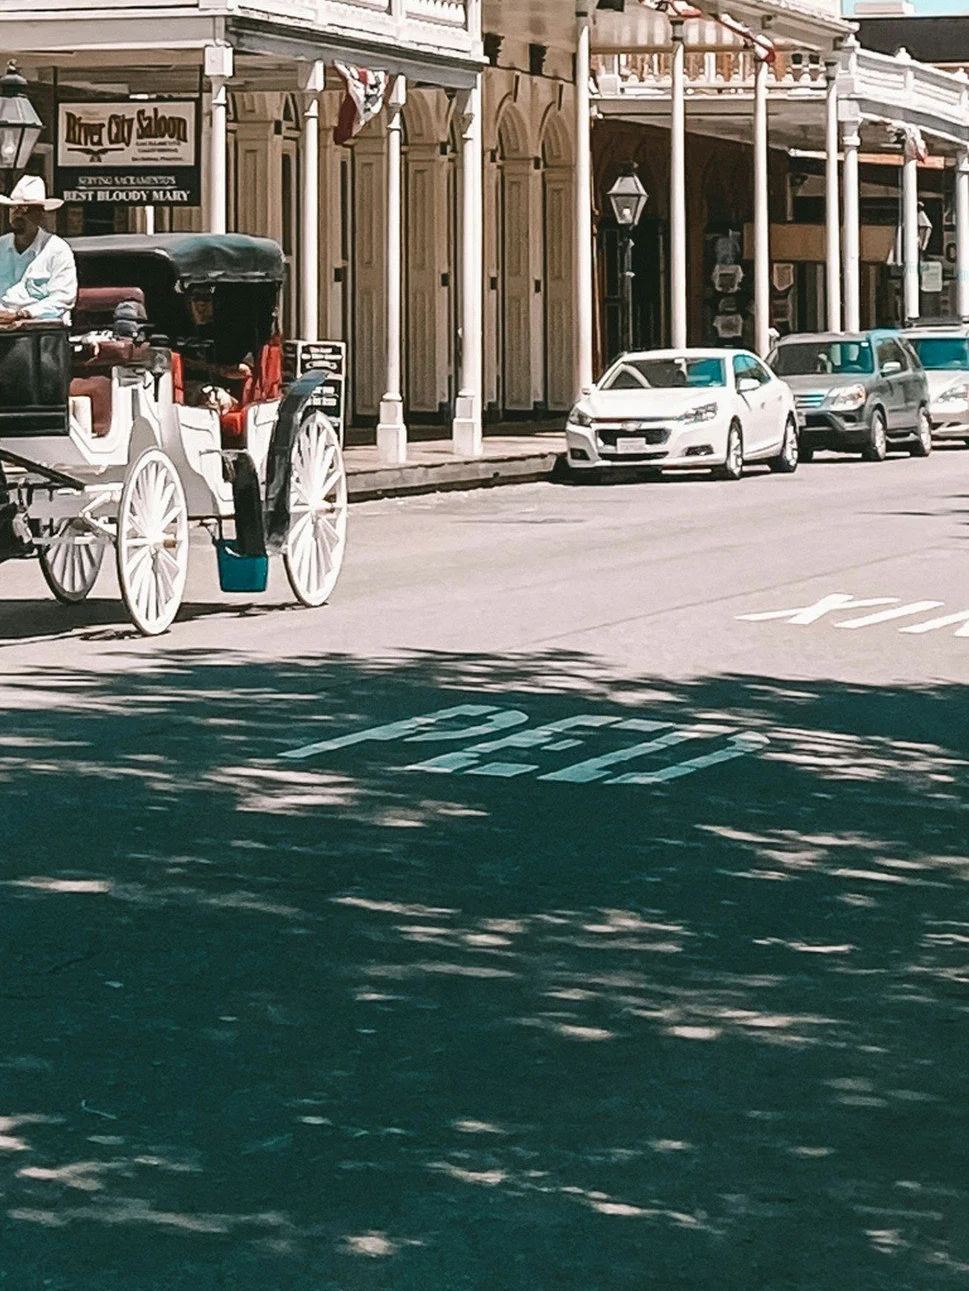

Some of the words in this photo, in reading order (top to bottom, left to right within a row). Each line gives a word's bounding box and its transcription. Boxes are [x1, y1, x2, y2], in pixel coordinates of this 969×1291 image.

[65, 111, 106, 147] River
[107, 113, 135, 148] City
[136, 107, 188, 143] Saloon
[63, 190, 94, 202] BEST
[96, 190, 150, 202] BLOODY
[152, 190, 191, 202] MARY
[277, 704, 771, 785] PED
